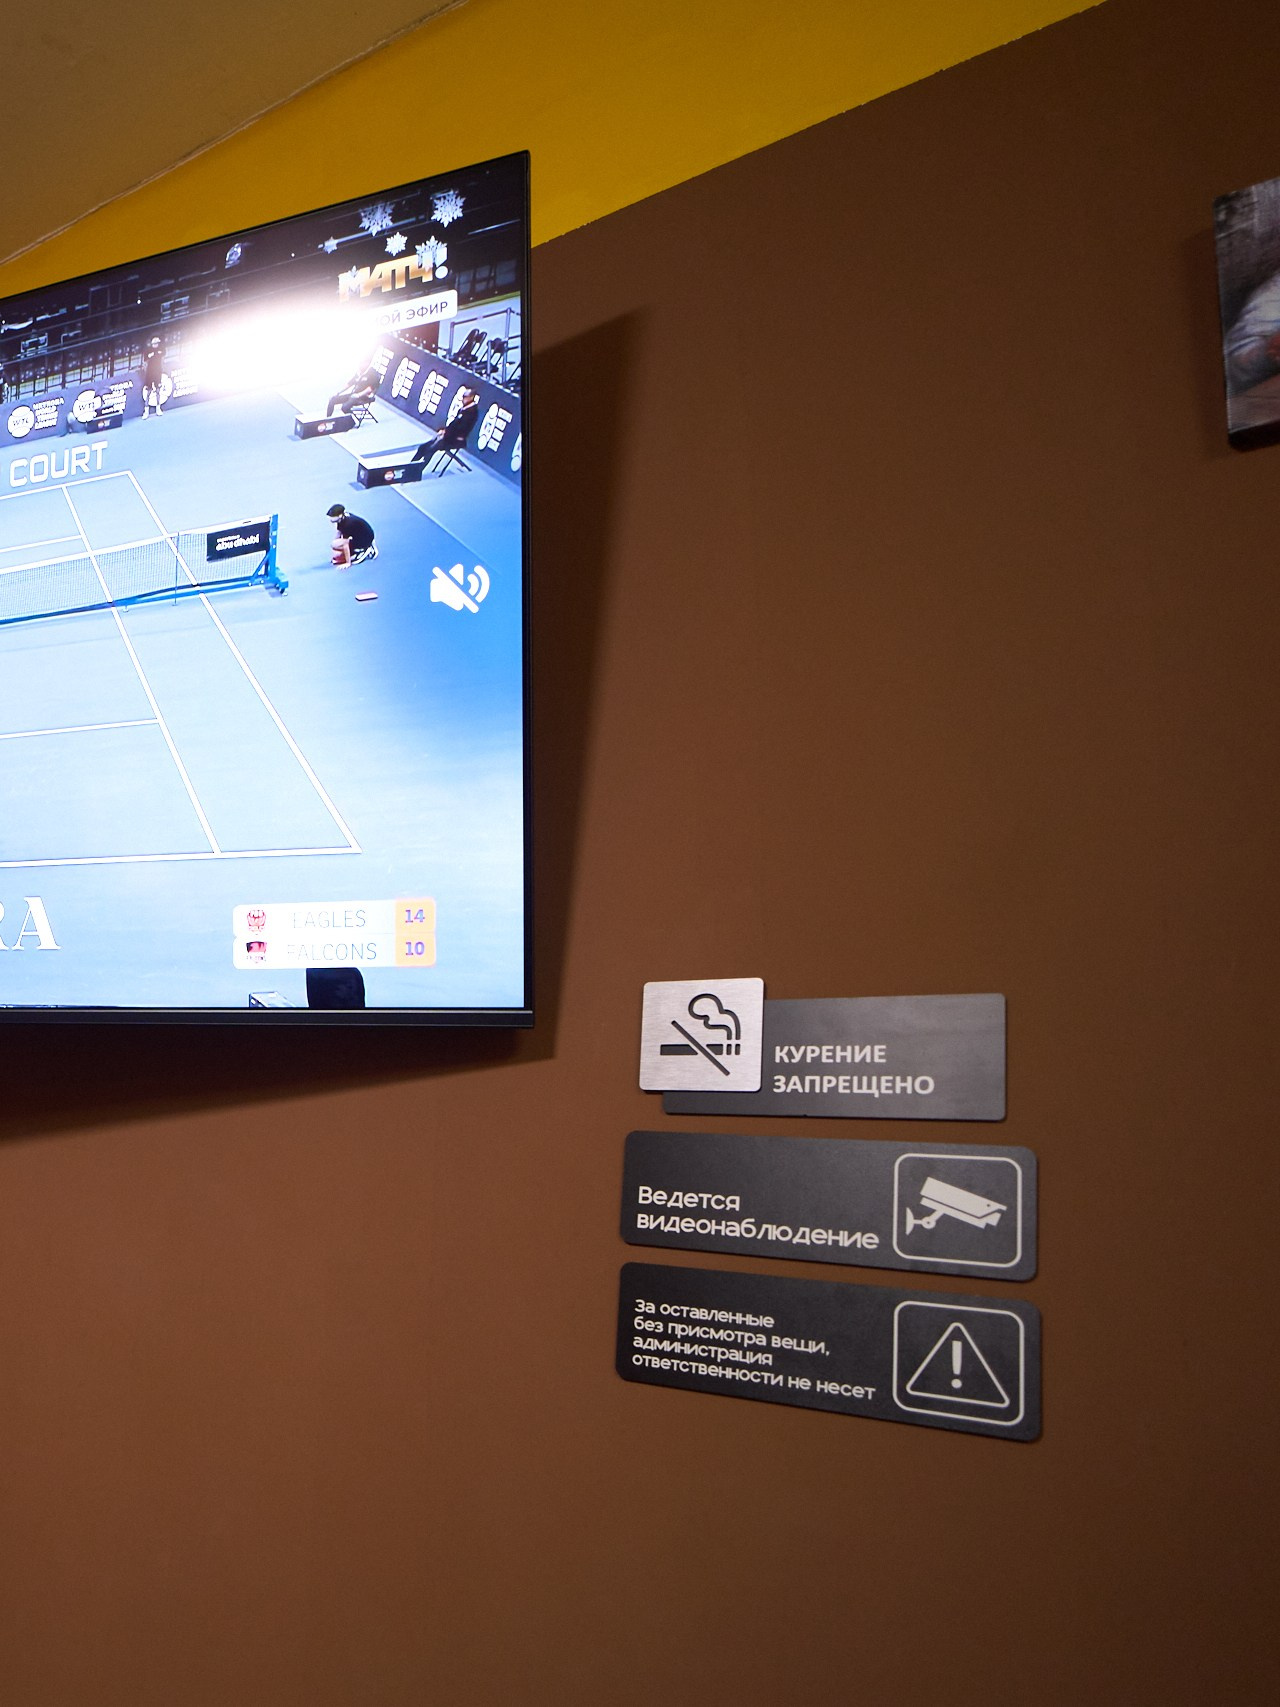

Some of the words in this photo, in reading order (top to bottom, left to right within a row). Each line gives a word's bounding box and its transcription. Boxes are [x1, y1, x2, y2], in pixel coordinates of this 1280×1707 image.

[406, 301, 448, 321] ЭФИР
[9, 440, 108, 493] COURT
[292, 909, 367, 929] EAGLES
[405, 909, 426, 924] 14
[287, 942, 377, 961] FALCONS
[405, 941, 425, 956] 10
[774, 1044, 887, 1065] КУРЕНИЕ
[773, 1074, 936, 1098] ЗАПРЕЩЕНО
[637, 1185, 741, 1212] Ведется
[636, 1213, 880, 1250] видеонаблюдение
[634, 1299, 655, 1314] За
[659, 1301, 775, 1329] оставленные
[633, 1315, 664, 1334] без
[667, 1321, 767, 1348] присмотра
[770, 1335, 830, 1357] вещи,
[632, 1335, 773, 1366] администрация
[631, 1353, 784, 1389] ответственности
[787, 1375, 812, 1391] не
[816, 1377, 876, 1401] несет
